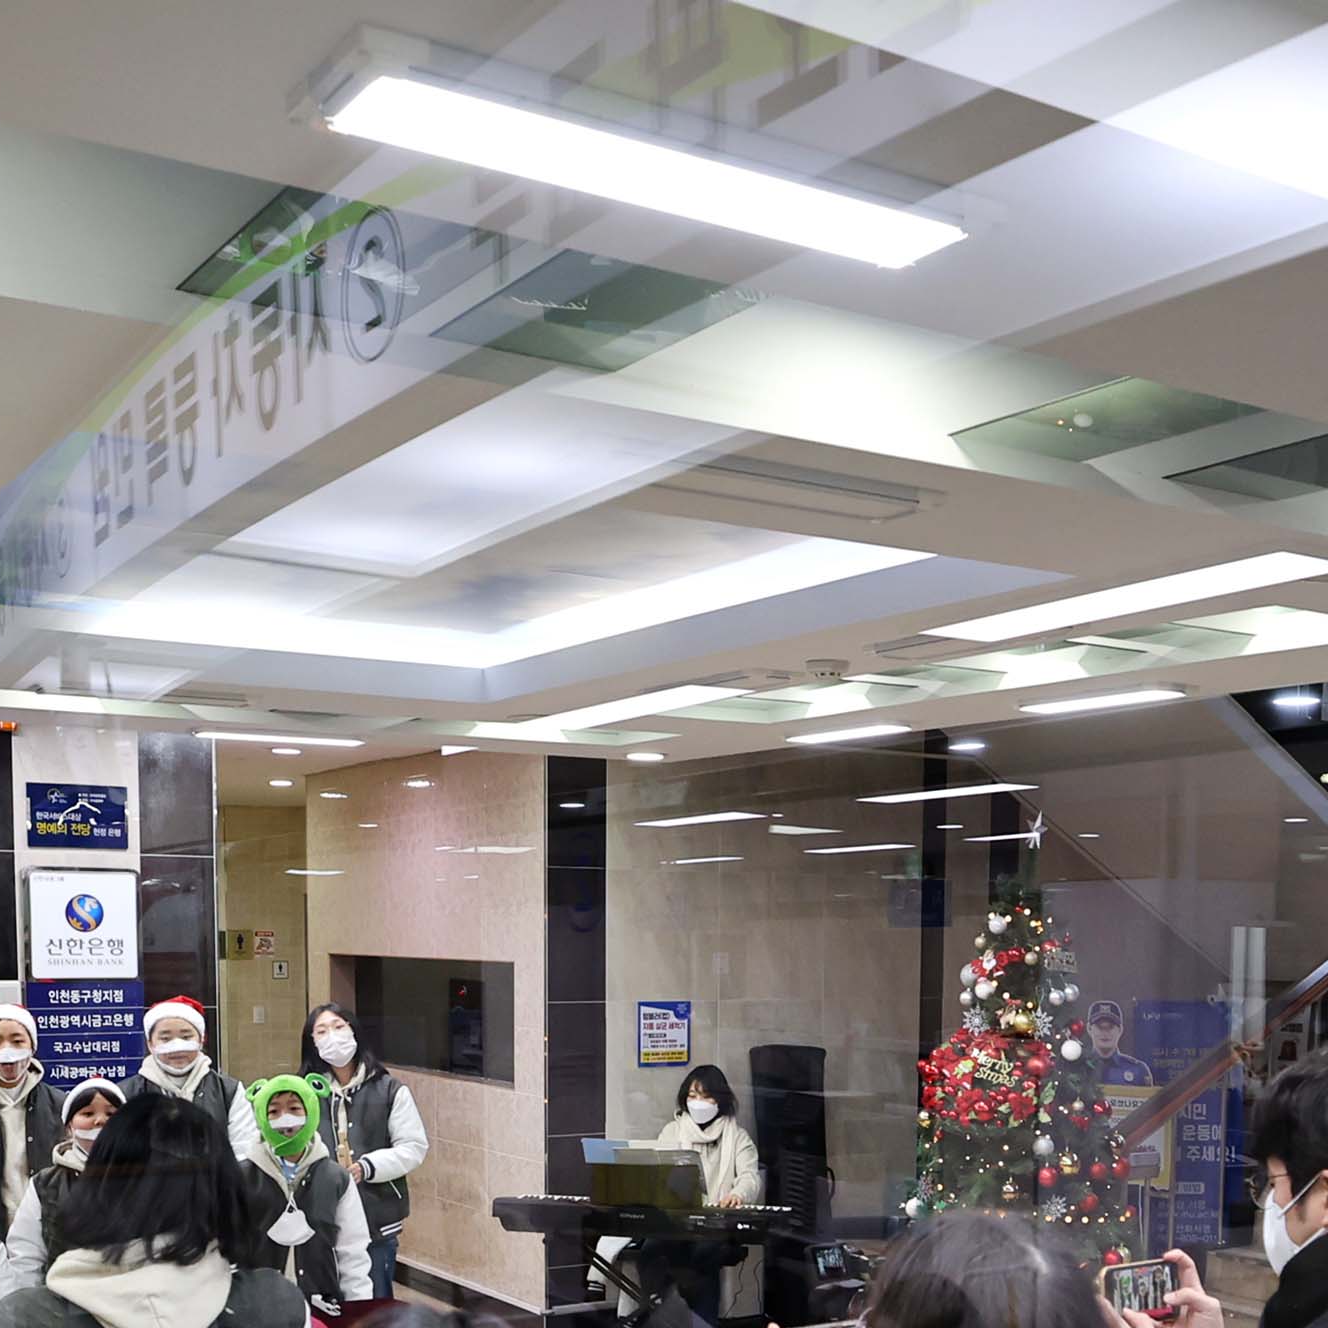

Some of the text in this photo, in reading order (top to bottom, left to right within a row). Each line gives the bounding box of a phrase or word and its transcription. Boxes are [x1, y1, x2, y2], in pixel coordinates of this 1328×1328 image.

[69, 823, 91, 837] 전당
[45, 937, 125, 957] 신한은행
[47, 959, 125, 967] SHINHAN BANK
[48, 988, 124, 1004] 인천동구청지점
[37, 1013, 135, 1029] 인천광역시금고은행
[53, 1040, 121, 1054] 국고수납대리점
[972, 1048, 1014, 1074] Merry
